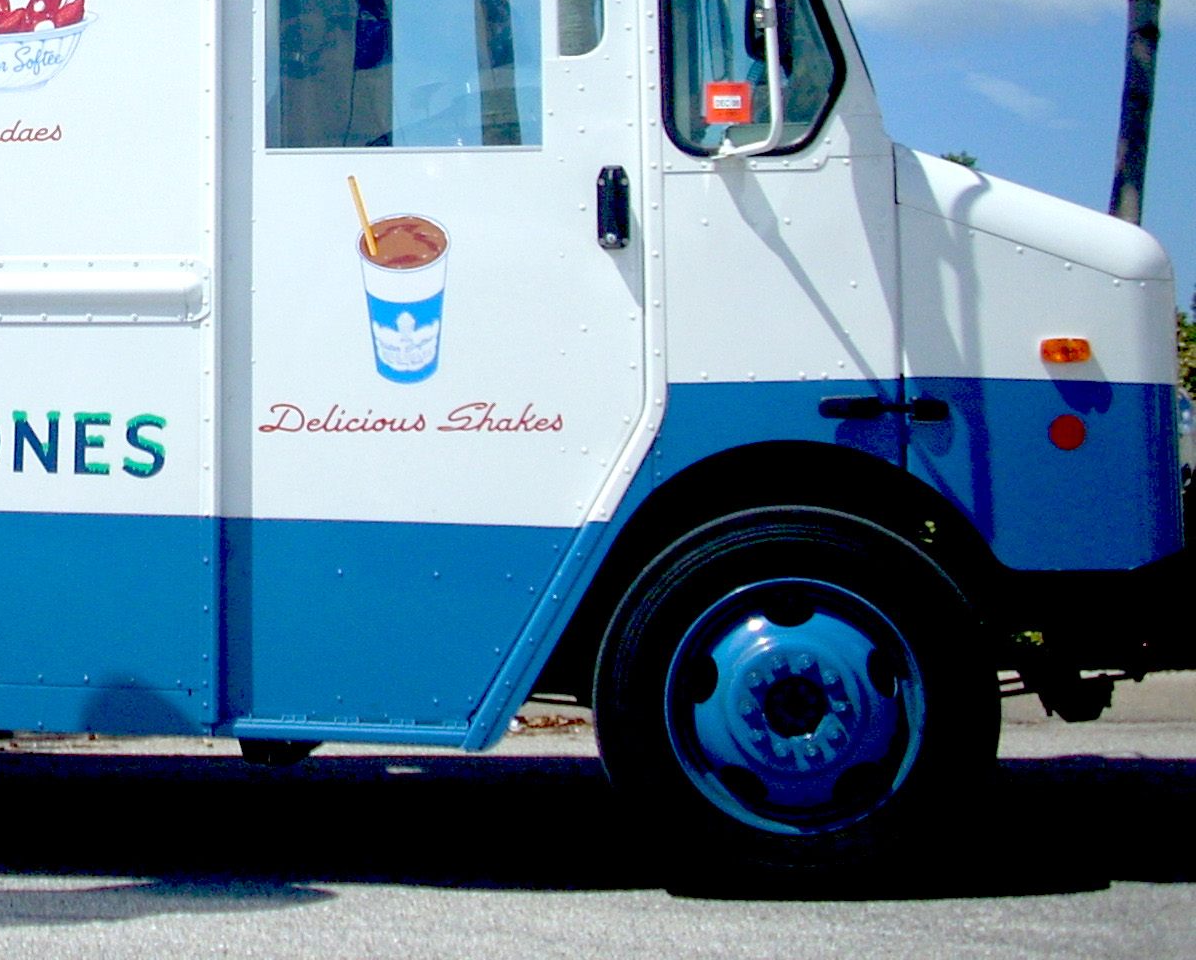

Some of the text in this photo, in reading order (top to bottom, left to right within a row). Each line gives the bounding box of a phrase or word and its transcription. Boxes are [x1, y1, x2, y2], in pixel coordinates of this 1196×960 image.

[12, 45, 65, 76] Softee
[257, 401, 564, 435] Delicious Shakes
